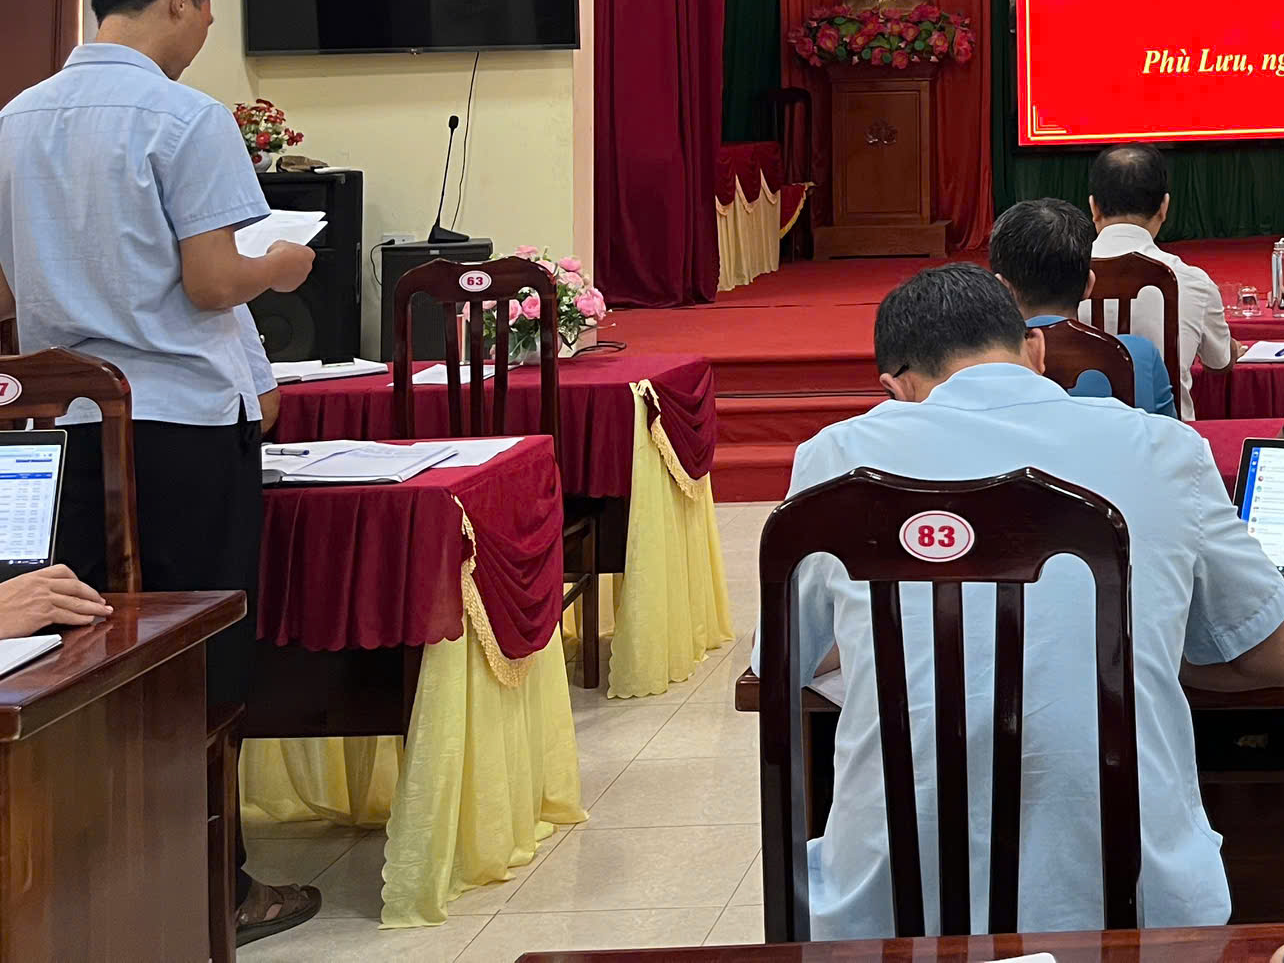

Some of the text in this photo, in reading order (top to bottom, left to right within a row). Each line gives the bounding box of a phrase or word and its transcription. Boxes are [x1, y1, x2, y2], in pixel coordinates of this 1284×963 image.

[1142, 48, 1191, 74] Phù
[1198, 48, 1254, 76] Lưu,
[467, 276, 483, 286] 63
[0, 383, 9, 396] 7
[918, 525, 955, 547] 83
